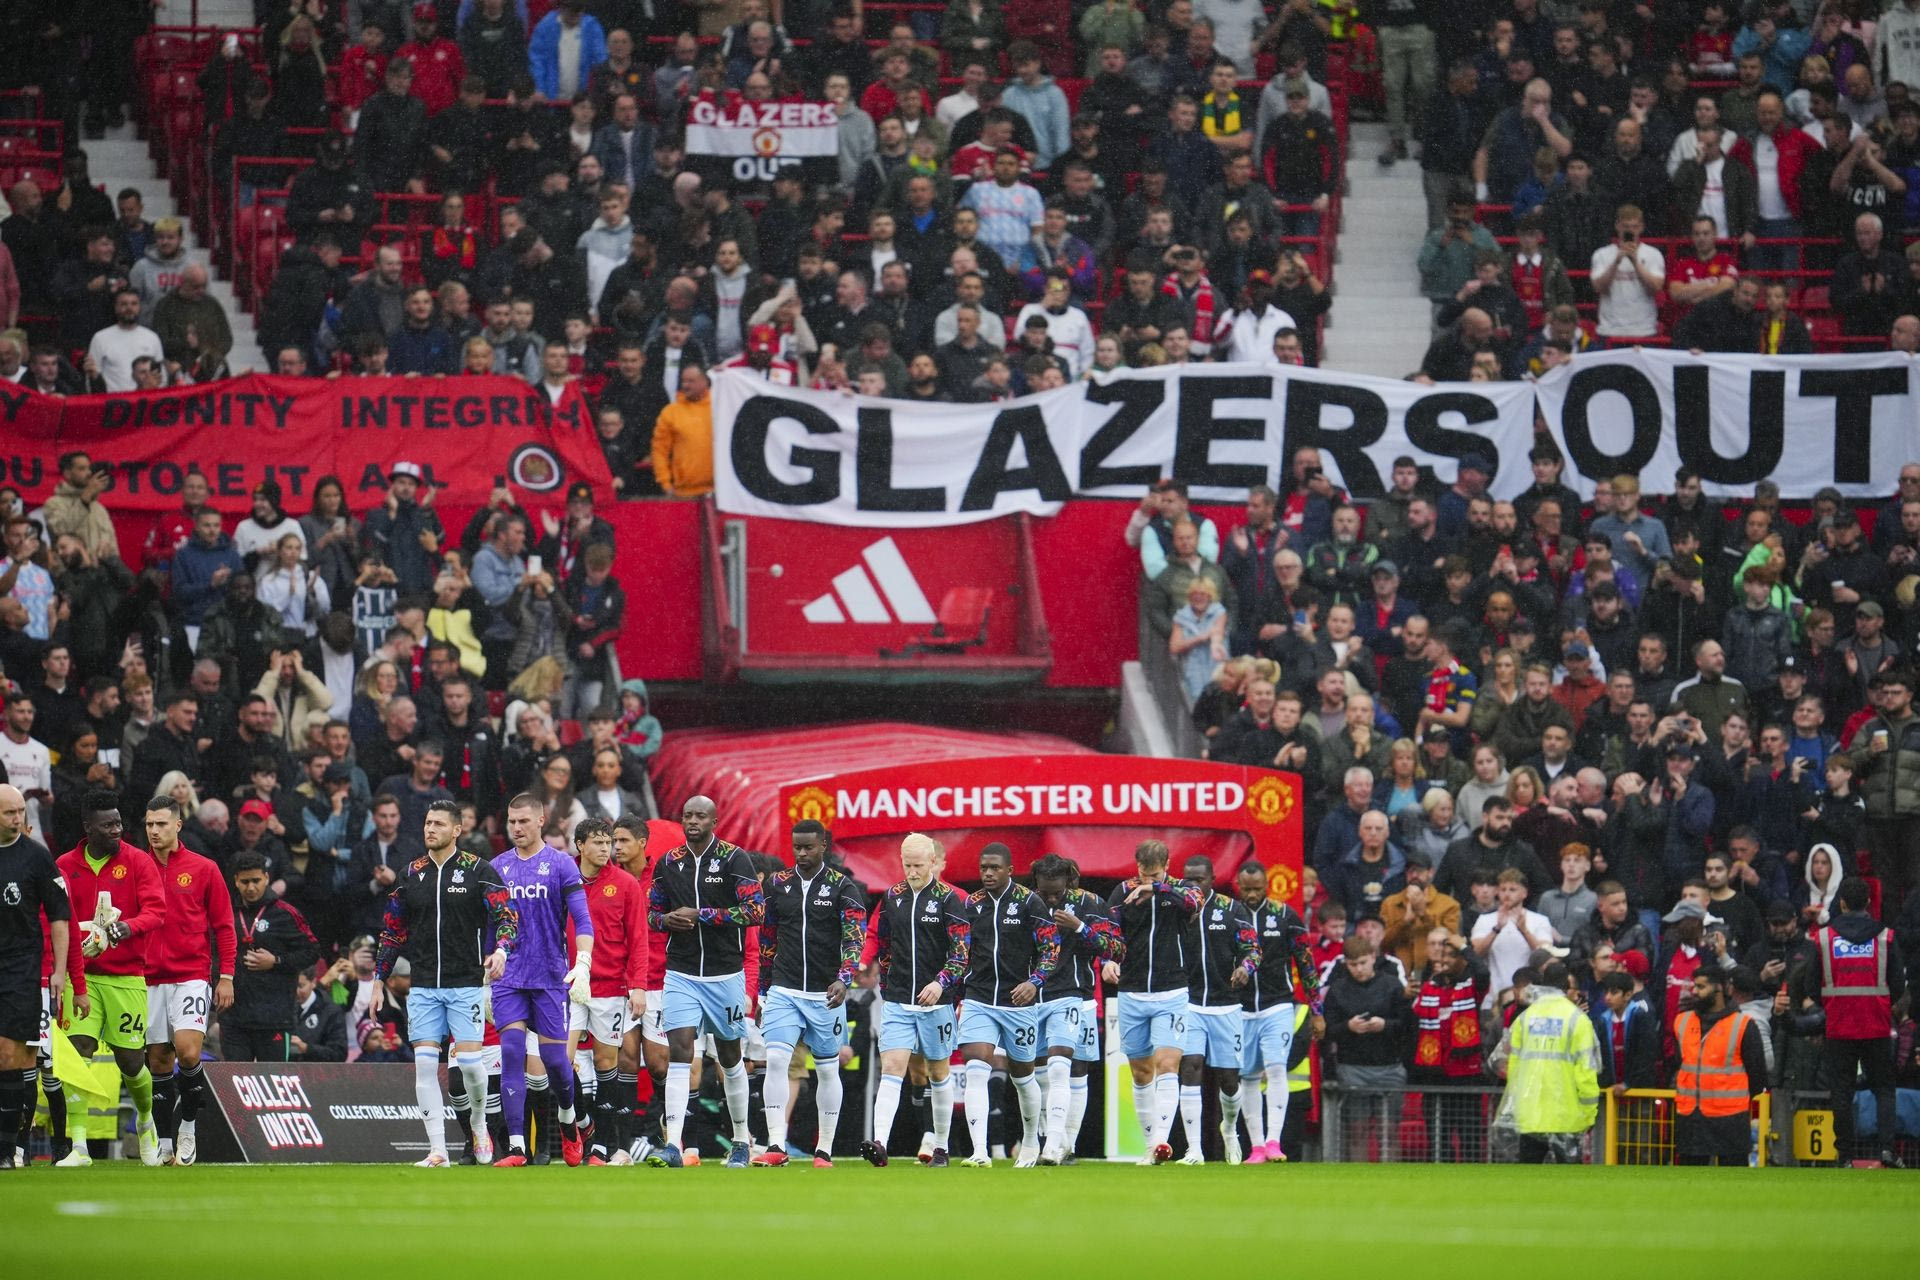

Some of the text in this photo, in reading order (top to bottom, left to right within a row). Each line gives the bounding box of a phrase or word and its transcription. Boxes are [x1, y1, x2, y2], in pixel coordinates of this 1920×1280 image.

[693, 101, 839, 127] GLAZERS
[101, 394, 294, 429] DIGNITY
[341, 395, 580, 431] INTEGRIY
[731, 363, 1909, 513] GLAZERS OUT
[359, 463, 449, 492] AL
[836, 783, 1093, 820] MANCHESTER
[1102, 781, 1244, 812] UNITED
[447, 885, 467, 893] cinch
[704, 875, 723, 883] cinch
[507, 880, 549, 899] inch
[813, 899, 833, 907] cinch
[921, 914, 940, 923] cinch
[1003, 916, 1021, 925] cinch
[1850, 943, 1874, 954] CSG
[182, 996, 207, 1017] 20
[470, 1003, 482, 1024] 2
[561, 1001, 568, 1023] 1
[725, 1004, 744, 1025] 14
[1064, 1007, 1079, 1026] 10
[119, 1012, 144, 1035] 24
[612, 1012, 622, 1032] 2
[655, 1010, 663, 1029] 1
[832, 1016, 843, 1036] 6
[1168, 1013, 1185, 1034] 16
[937, 1021, 953, 1044] 19
[1014, 1025, 1036, 1047] 28
[1082, 1027, 1095, 1046] 15
[1281, 1031, 1291, 1047] 9
[1233, 1034, 1242, 1052] 3
[232, 1074, 313, 1110] COLLECT
[329, 1104, 458, 1121] COLLECTIBLES.MANCO
[1806, 1114, 1825, 1126] WSP
[256, 1112, 325, 1150] UNITED
[1810, 1128, 1823, 1156] 6
